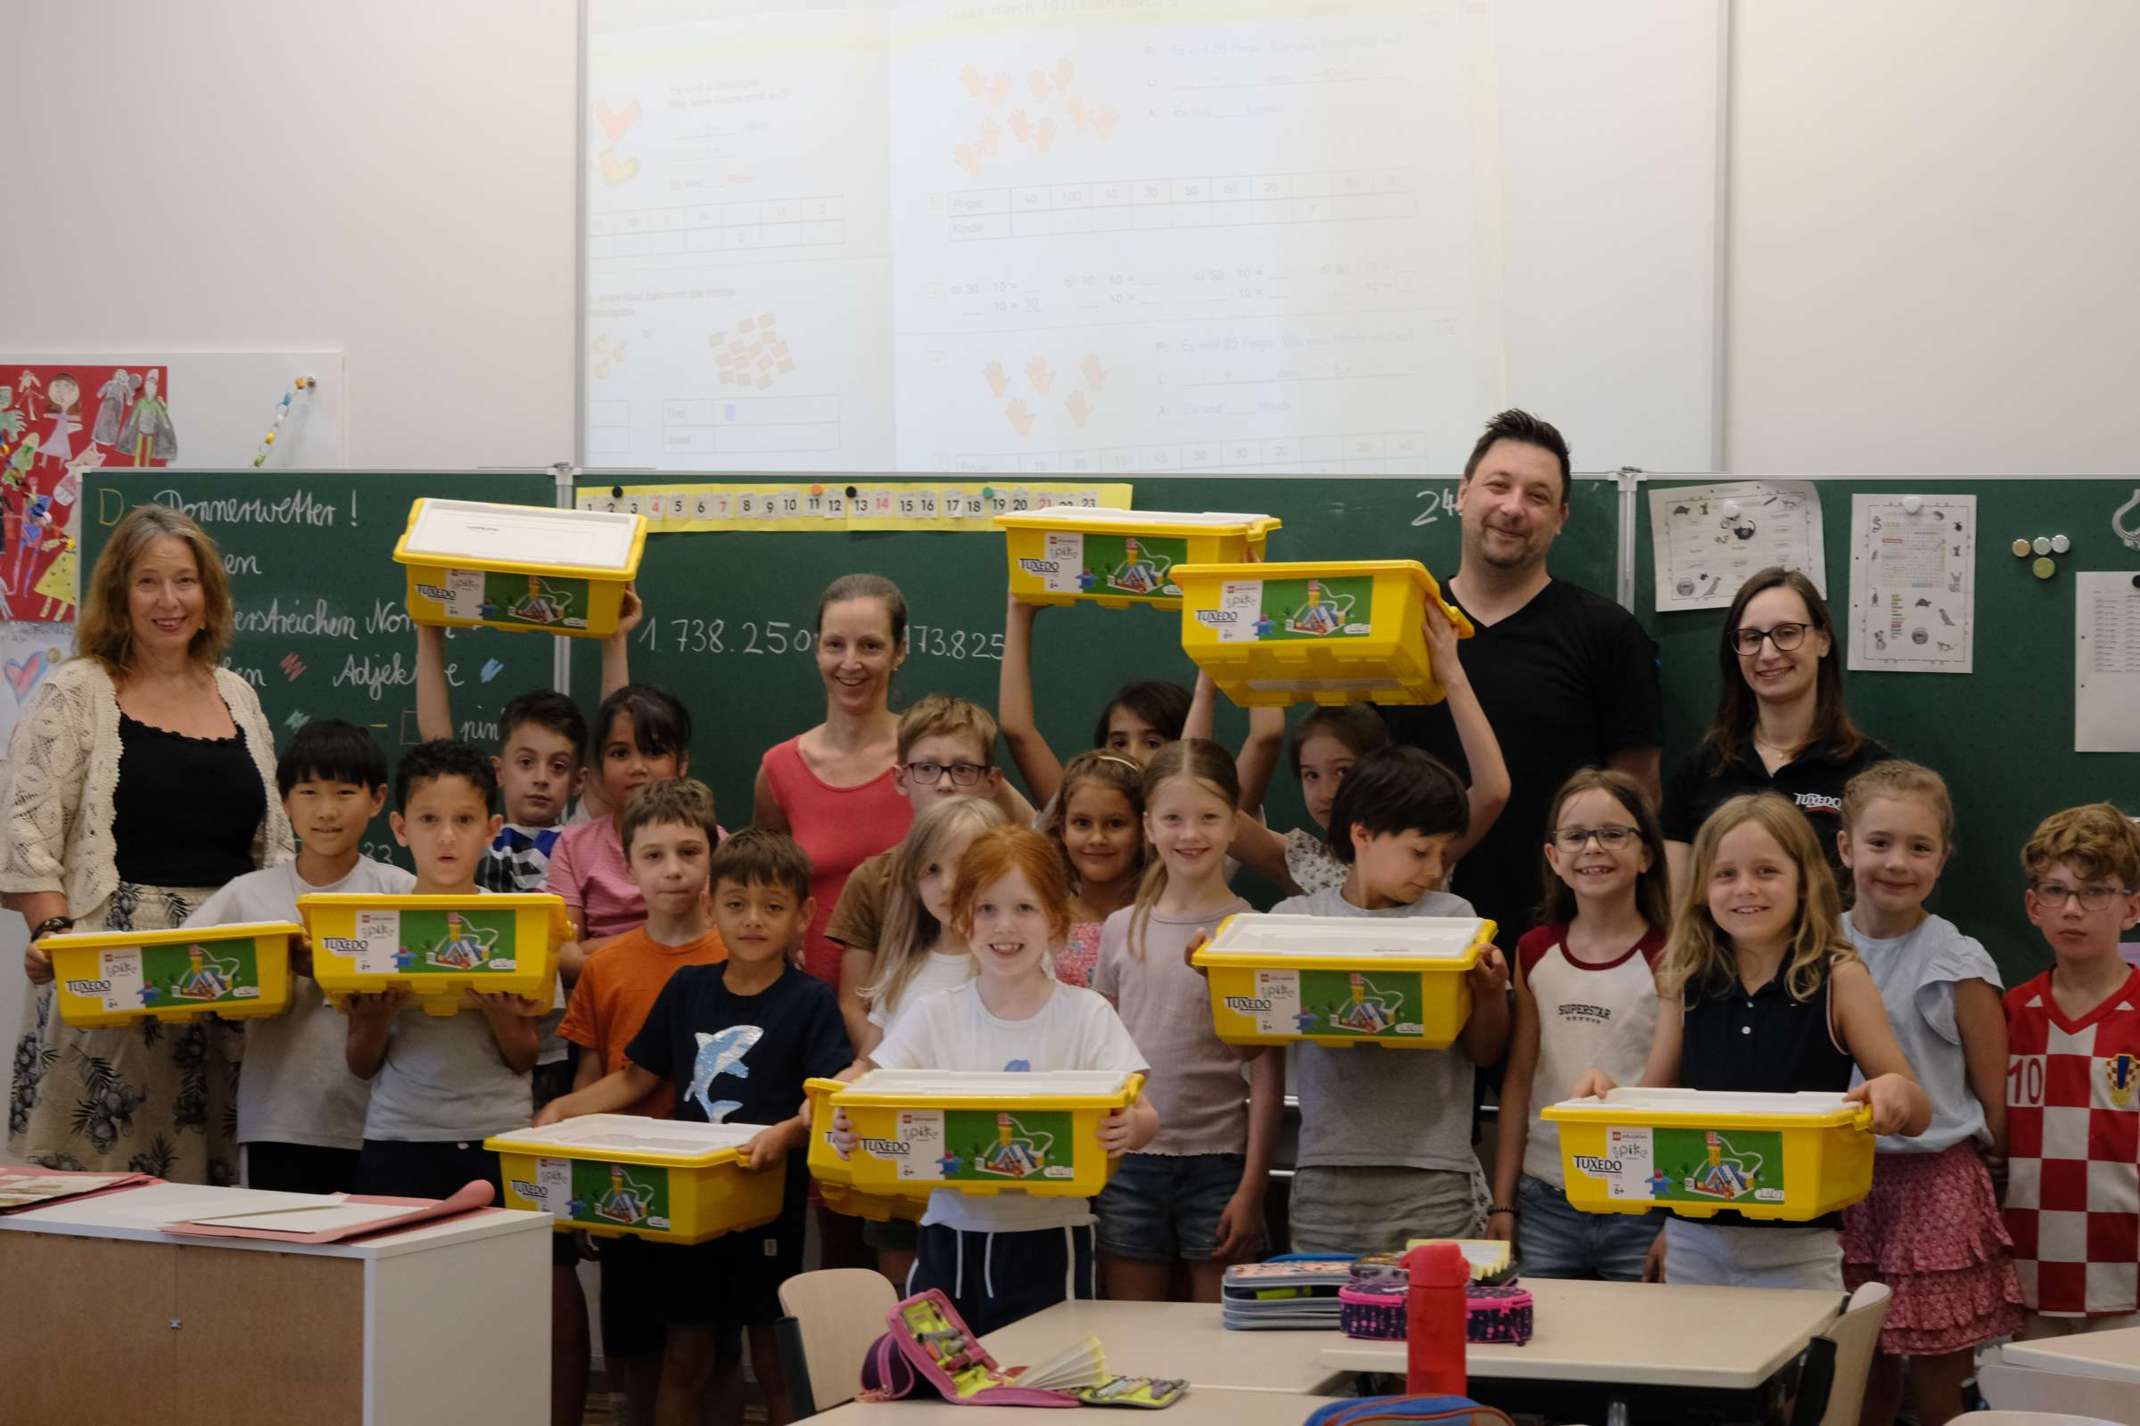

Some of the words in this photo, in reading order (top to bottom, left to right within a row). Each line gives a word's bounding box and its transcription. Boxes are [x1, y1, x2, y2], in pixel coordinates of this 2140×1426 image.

[607, 502, 616, 513] 2
[630, 503, 638, 514] 3
[651, 501, 660, 513] 4
[675, 500, 683, 512] 5
[697, 501, 706, 513] 6
[720, 500, 728, 512] 7
[743, 499, 751, 511] 8
[766, 501, 775, 513] 9
[784, 499, 797, 511] 10
[808, 498, 820, 510] 11
[829, 499, 842, 512] 12
[855, 499, 868, 512] 13
[876, 497, 889, 510] 14
[900, 500, 913, 512] 15
[921, 499, 934, 511] 16
[946, 499, 960, 511] 17
[967, 500, 981, 513] 18
[993, 498, 1006, 510] 19
[1013, 498, 1028, 511] 20
[1019, 558, 1060, 573] TUXEDO
[1196, 609, 1239, 623] TUXEDO
[323, 937, 369, 952] TUXEDO
[66, 980, 111, 994] TUXEDO
[1224, 996, 1272, 1011] TUXEDO
[2008, 1058, 2042, 1104] 10
[862, 1137, 911, 1154] TUXEDO
[1573, 1154, 1623, 1173] TUXEDO
